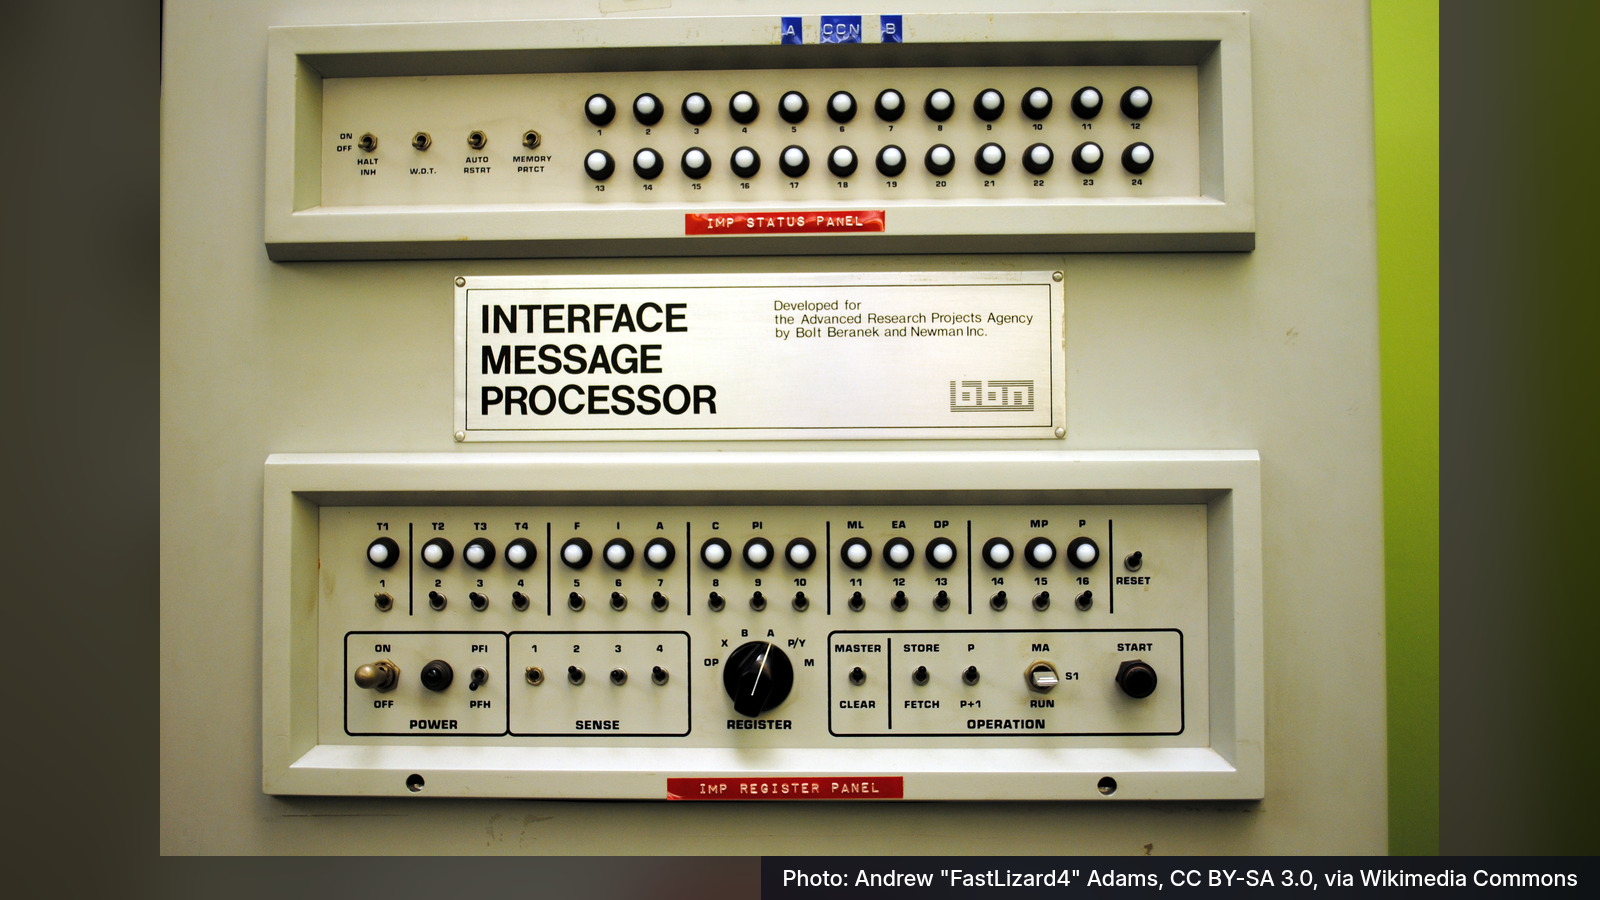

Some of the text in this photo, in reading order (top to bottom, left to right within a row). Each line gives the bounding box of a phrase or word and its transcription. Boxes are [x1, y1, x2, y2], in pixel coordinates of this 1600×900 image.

[786, 24, 796, 36] A
[822, 24, 860, 36] CCN
[886, 22, 896, 34] B
[596, 128, 604, 136] 1
[646, 128, 652, 136] 2
[336, 144, 352, 152] OFF
[358, 158, 378, 166] HALT
[706, 214, 864, 230] IMP STATUS PANEL
[774, 300, 862, 312] Developed for
[482, 302, 687, 333] INTERFACE
[774, 312, 1034, 326] the Advanced Research Projects Agency
[776, 326, 988, 340] by Bolt Beranek and Newman Inc.
[482, 344, 662, 374] MESSAGE
[482, 384, 716, 415] PROCESSOR
[376, 522, 388, 530] T1
[432, 522, 444, 530] T2
[474, 522, 488, 530] T3
[514, 522, 528, 530] T4
[574, 522, 580, 530] F
[656, 522, 664, 530] A
[712, 522, 720, 530] C
[752, 522, 762, 530] PI
[846, 520, 864, 530] ML
[892, 520, 906, 528] EA
[1030, 520, 1048, 528] MP
[1078, 520, 1086, 528] P
[380, 580, 386, 588] 1
[434, 578, 442, 588] 2
[476, 578, 484, 588] 3
[518, 578, 524, 588] 4
[574, 578, 580, 588] 5
[614, 578, 622, 586] 6
[658, 578, 664, 586] 7
[712, 578, 720, 588] 8
[754, 578, 762, 586] 9
[794, 578, 806, 586] 10
[850, 578, 862, 586] 11
[892, 578, 906, 586] 12
[934, 578, 948, 586] 13
[992, 576, 1004, 586] 14
[1034, 576, 1048, 586] 15
[1076, 576, 1090, 586] 16
[1116, 576, 1150, 586] RESET
[742, 628, 748, 638] B
[766, 628, 774, 638] A
[722, 638, 728, 648] X
[788, 638, 806, 648] P/Y
[1118, 642, 1152, 652] START
[374, 644, 390, 652] ON
[472, 644, 488, 652] PFI
[532, 644, 538, 652] 1
[574, 644, 580, 652] 2
[614, 644, 622, 652] 3
[656, 644, 664, 652] 4
[834, 644, 882, 652] MASTER
[904, 644, 940, 652] STORE
[968, 644, 974, 652] P
[1032, 644, 1050, 652] MA
[704, 658, 720, 666] OP
[804, 658, 814, 666] M
[1066, 672, 1078, 680] S1
[374, 700, 394, 708] OFF
[470, 700, 490, 708] PFH
[840, 700, 876, 708] CLEAR
[904, 700, 940, 708] FETCH
[960, 700, 980, 708] P+1
[1030, 698, 1054, 708] RUN
[410, 720, 458, 730] POWER
[576, 720, 620, 730] SENSE
[726, 720, 792, 730] REGISTER
[966, 718, 1046, 730] OPERATION
[700, 782, 880, 796] IMP REGISTER PANEL
